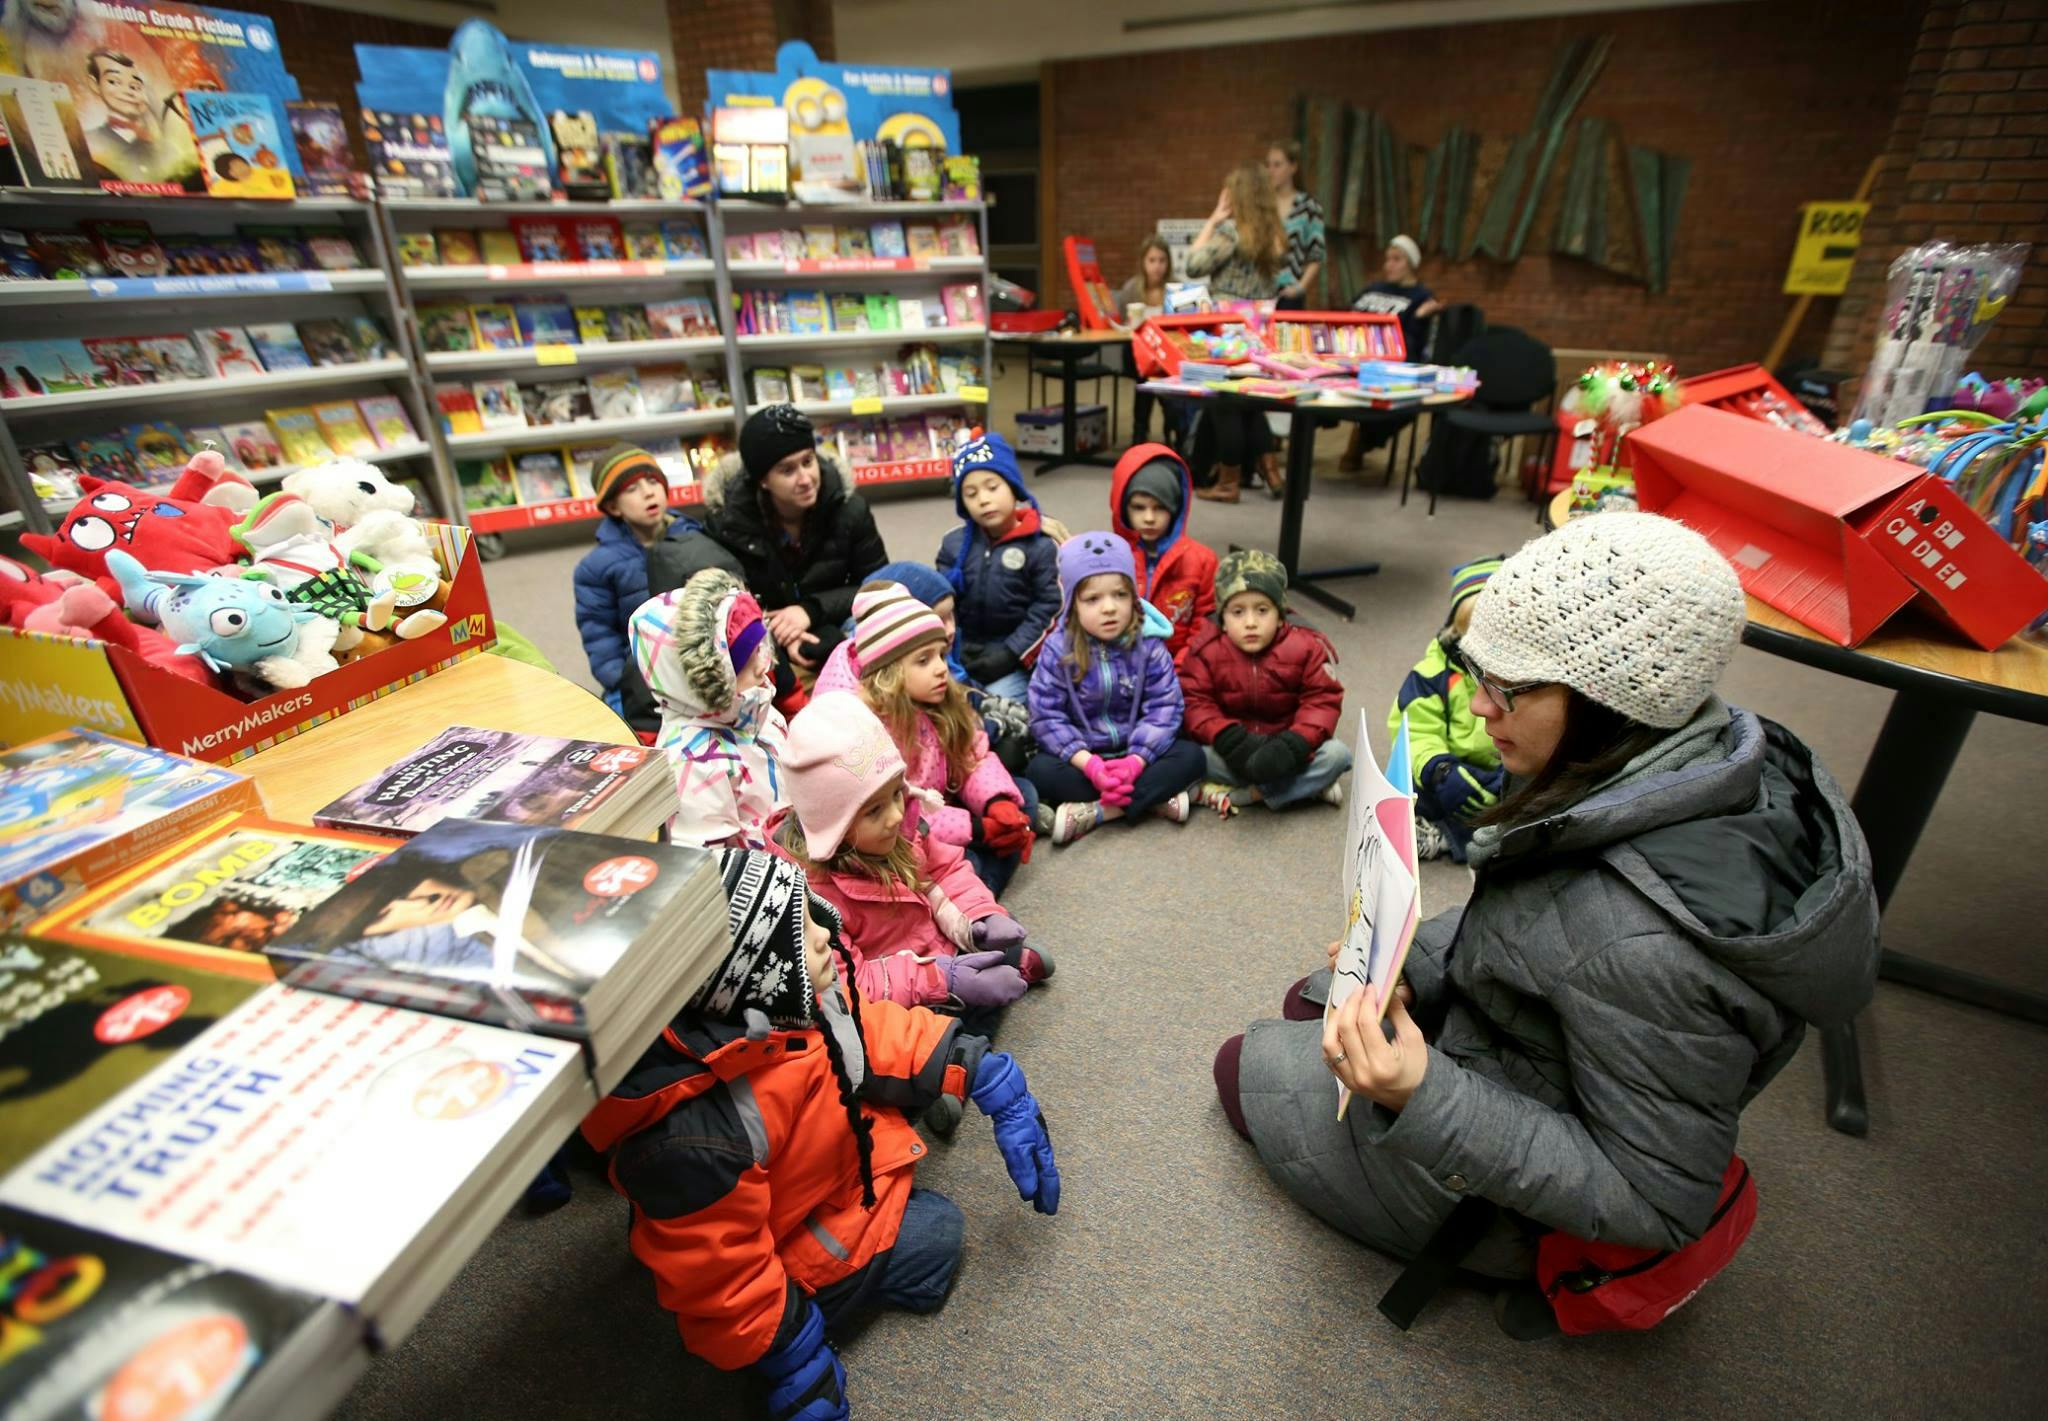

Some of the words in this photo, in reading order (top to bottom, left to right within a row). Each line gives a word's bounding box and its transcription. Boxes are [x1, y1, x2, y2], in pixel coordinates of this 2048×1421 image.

[148, 9, 196, 30] Grade
[193, 15, 245, 39] Fiction
[1886, 517, 1906, 535] C
[1911, 540, 1932, 558] D
[1935, 562, 1957, 581] E
[1932, 520, 1954, 539] B
[182, 691, 313, 757] MerryMakers
[376, 743, 472, 802] HAUNTING
[127, 838, 276, 931] BOMB
[35, 1056, 224, 1187] NOTHING
[91, 1069, 283, 1202] TRUTH
